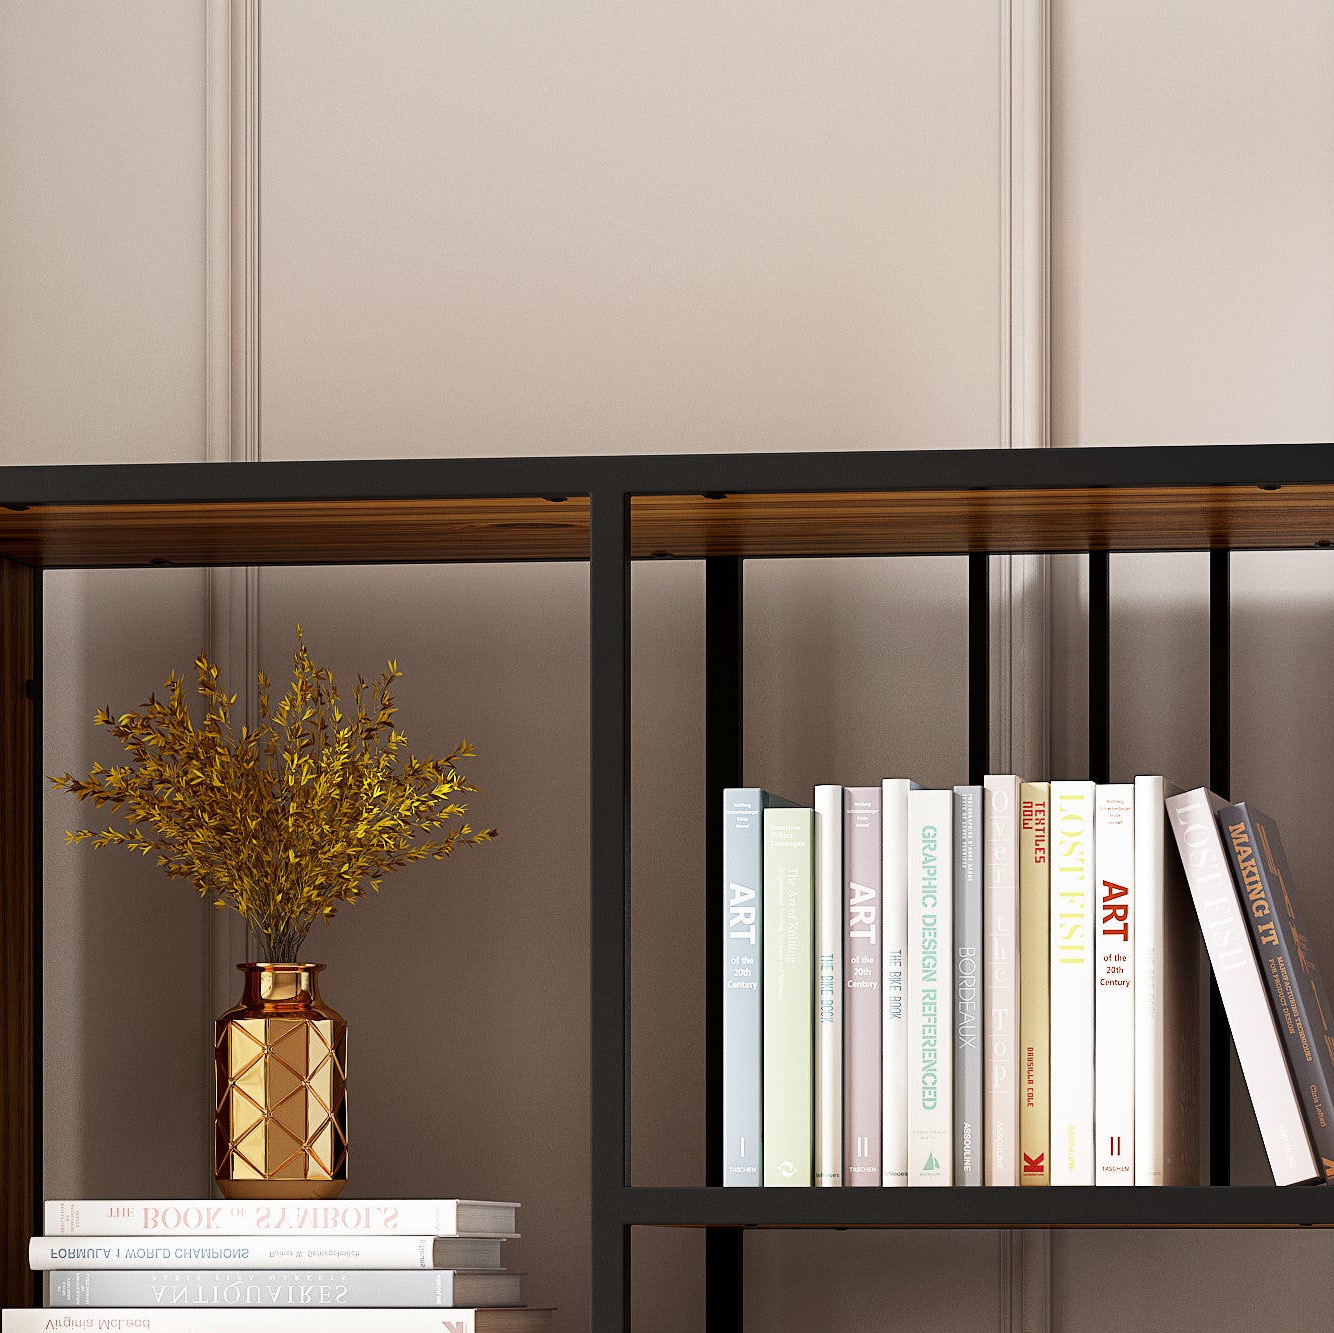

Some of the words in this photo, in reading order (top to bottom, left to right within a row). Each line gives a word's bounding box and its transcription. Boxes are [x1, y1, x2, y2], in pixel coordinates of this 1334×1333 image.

[1035, 801, 1046, 864] TEXTILES
[1059, 795, 1084, 881] LOST
[922, 825, 937, 909] GRAPHIC
[1229, 821, 1270, 918] MAKING
[1257, 921, 1280, 946] IT
[730, 883, 756, 944] ART
[850, 882, 876, 944] ART
[1102, 879, 1128, 942] ART
[730, 957, 740, 965] of
[742, 957, 754, 965] the
[851, 957, 860, 965] of
[862, 957, 874, 965] the
[922, 914, 937, 982] DESIGN
[1103, 953, 1113, 962] of
[1114, 953, 1127, 962] the
[727, 980, 758, 990] Century
[847, 980, 878, 990] Century
[958, 947, 976, 1049] BORDEAUX
[1100, 978, 1131, 988] Century
[922, 988, 937, 1111] REFERENCED
[963, 1121, 971, 1172] ASSOULINE
